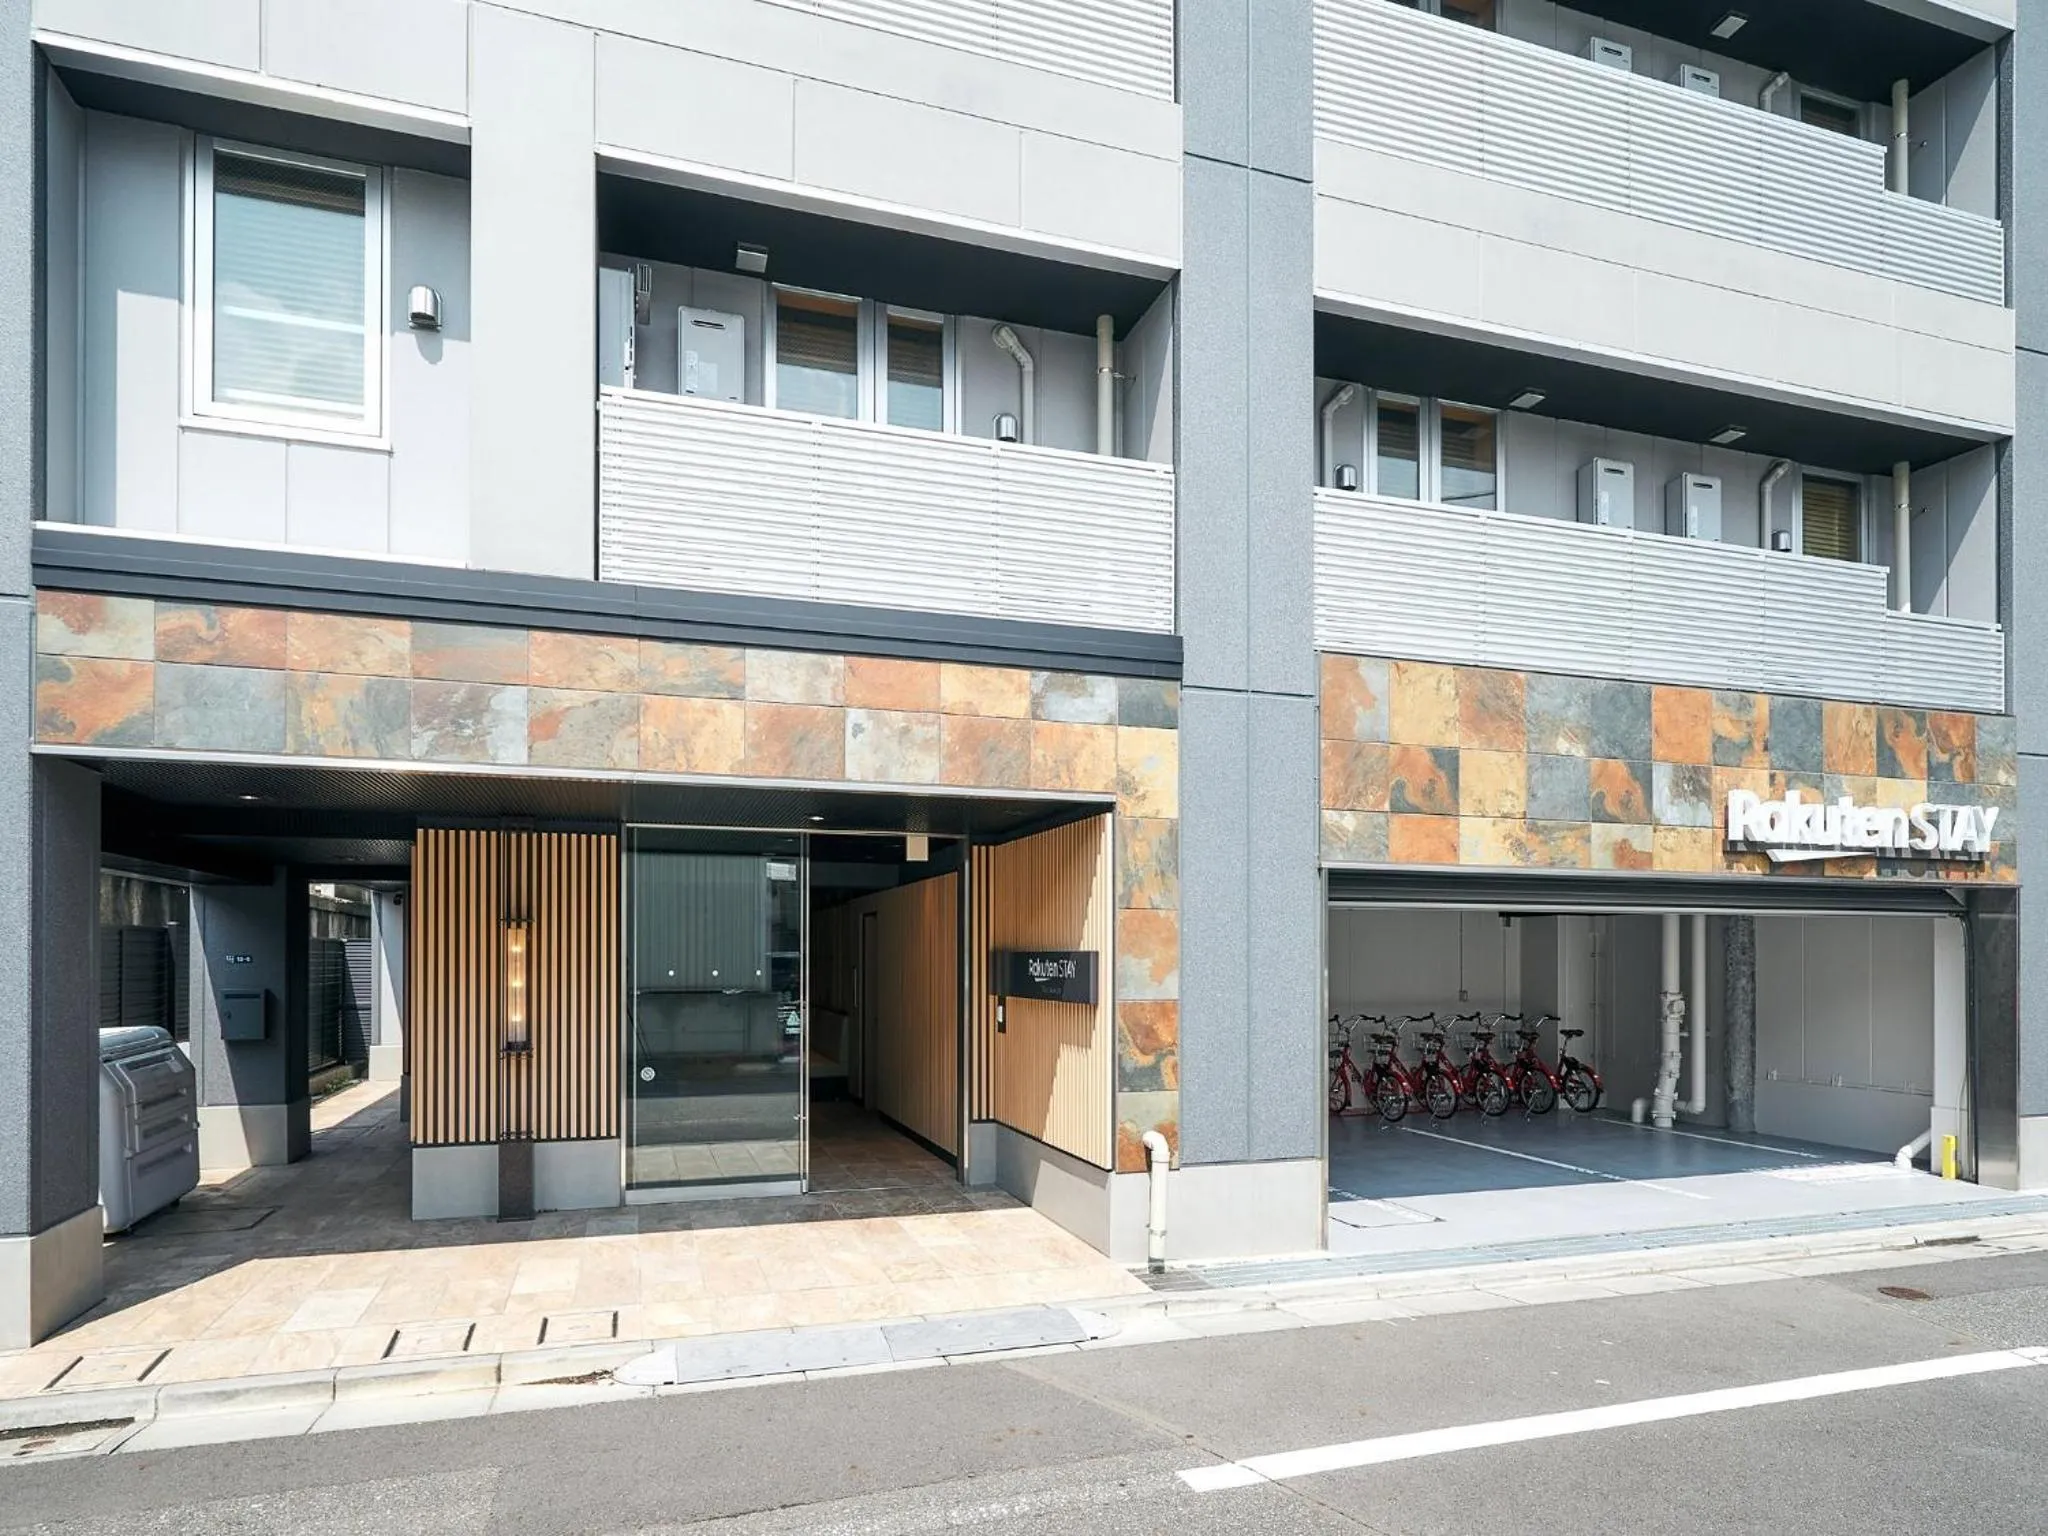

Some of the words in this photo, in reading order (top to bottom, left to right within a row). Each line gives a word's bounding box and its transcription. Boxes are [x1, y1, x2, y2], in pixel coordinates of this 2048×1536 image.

[1727, 789, 1909, 849] Rakuten
[1909, 802, 1999, 852] STAY
[1028, 958, 1058, 977] Rakuten
[1059, 959, 1077, 979] STAY
